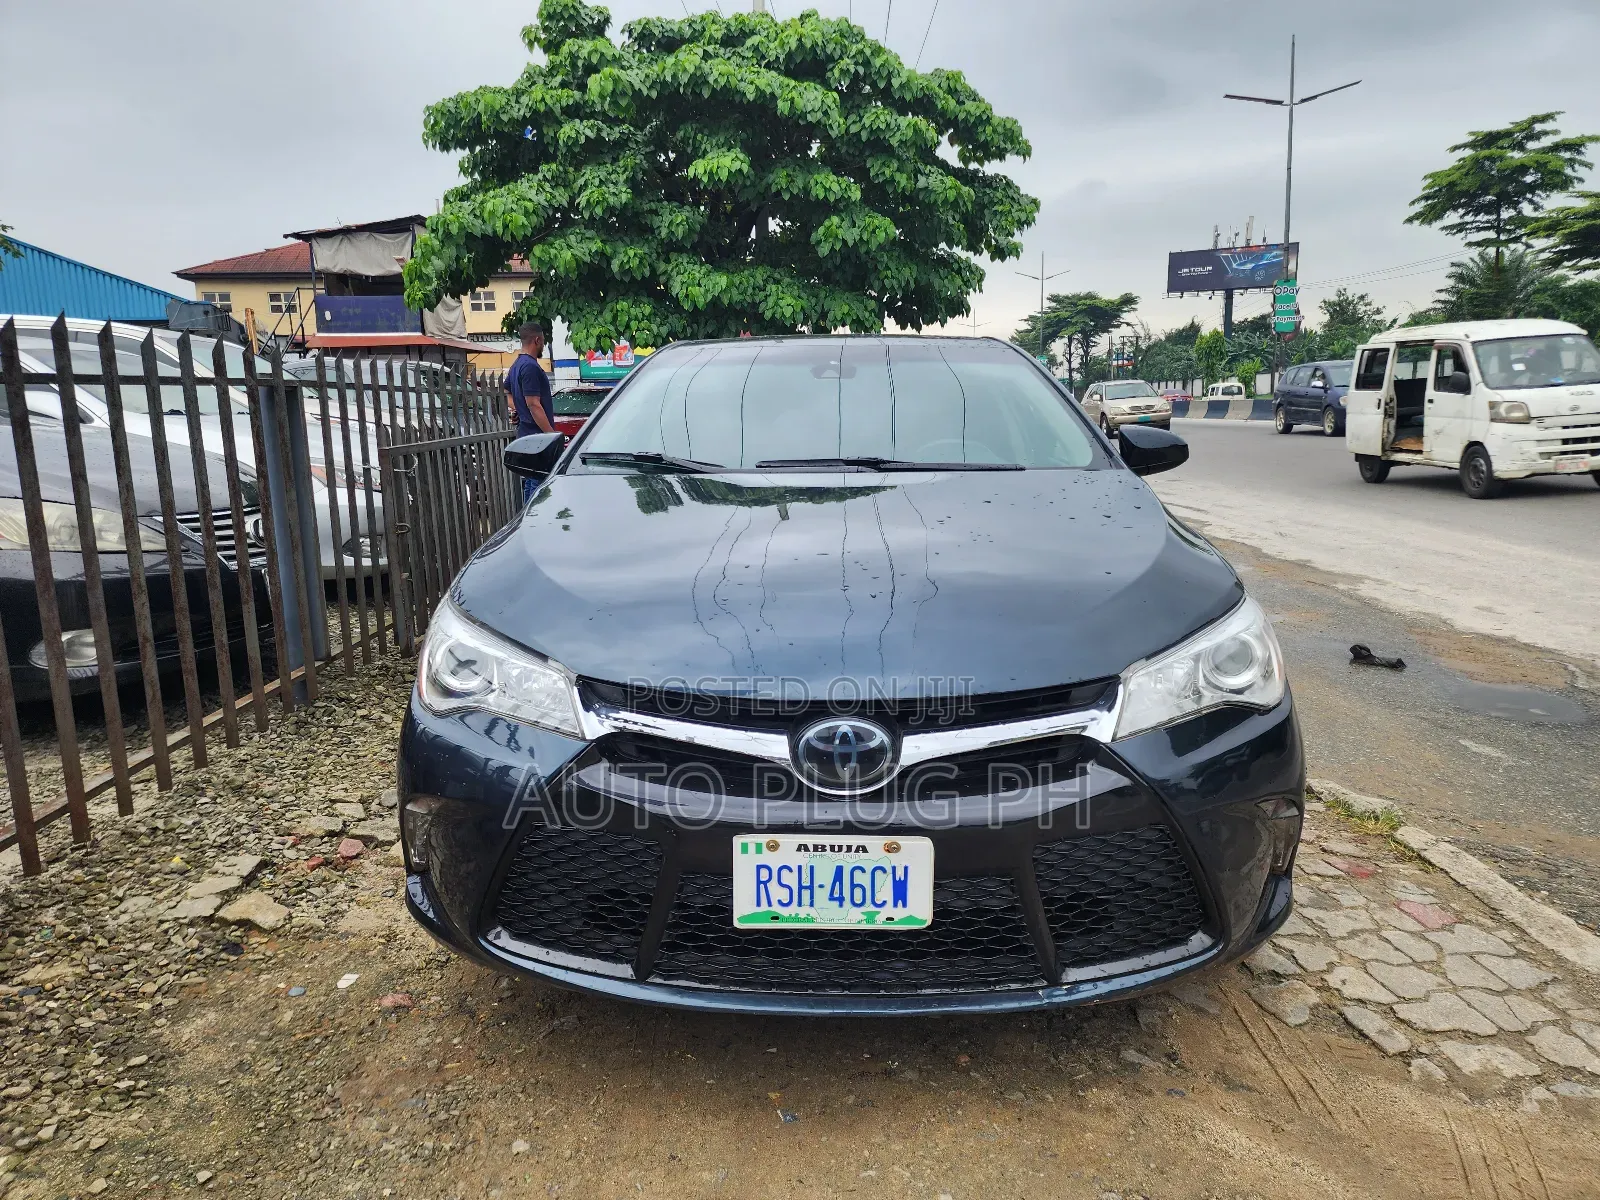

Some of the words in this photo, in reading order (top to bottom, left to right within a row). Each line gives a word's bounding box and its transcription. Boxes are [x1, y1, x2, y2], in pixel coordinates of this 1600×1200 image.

[1274, 286, 1300, 296] OPay
[467, 334, 513, 342] FITNESS
[795, 843, 869, 853] ABUJA
[755, 864, 909, 908] RSH-46CW
